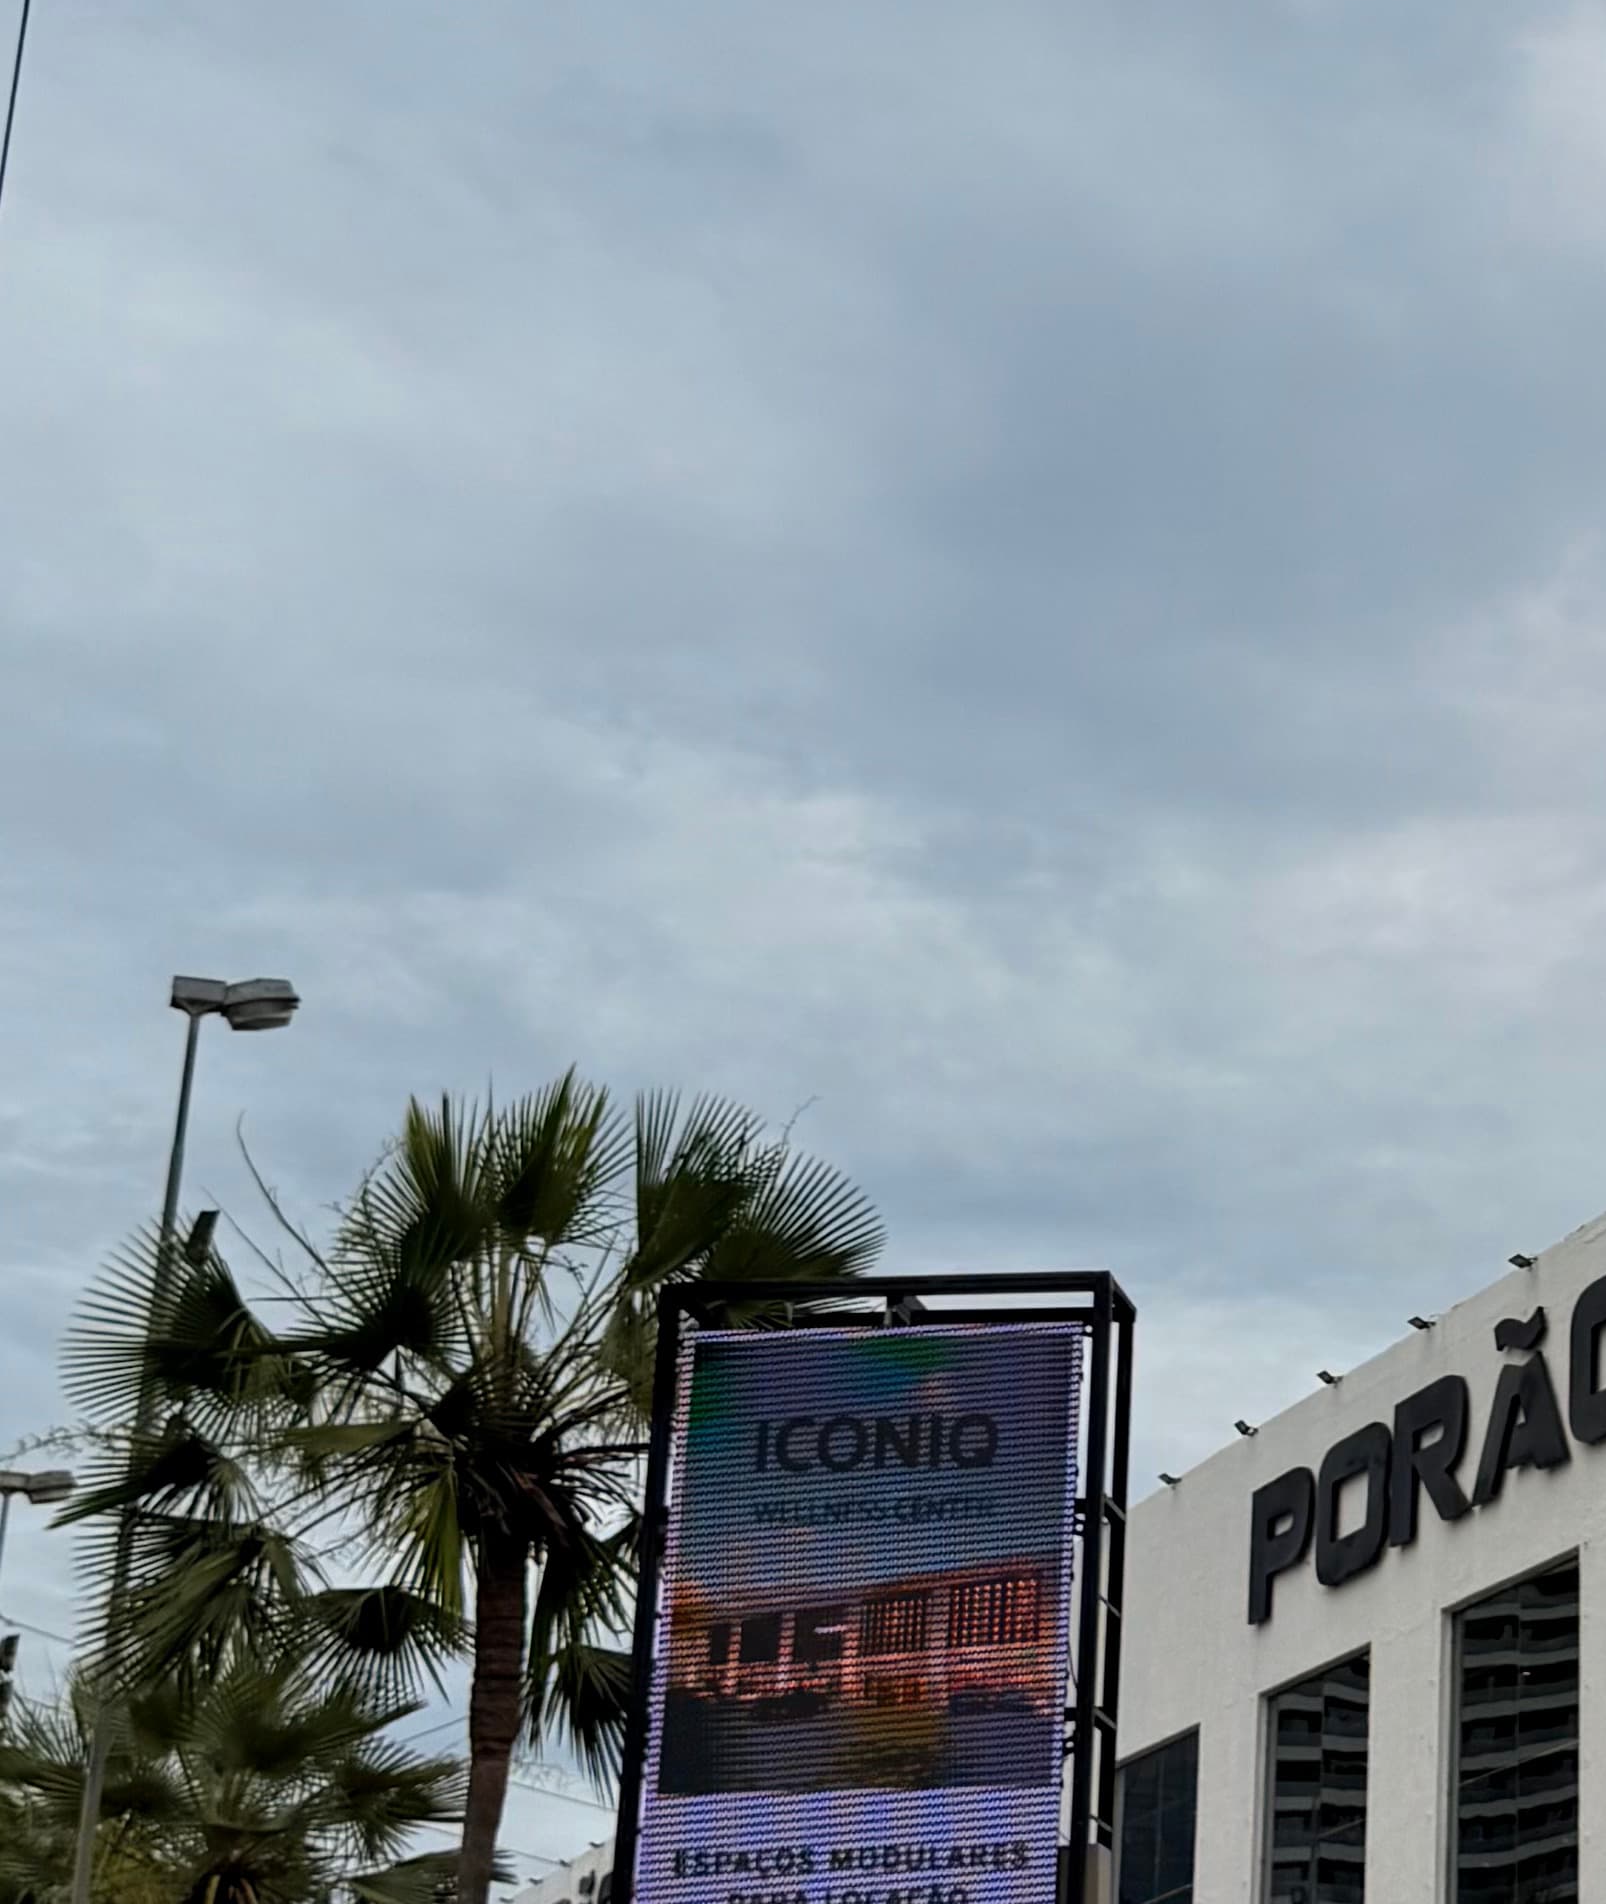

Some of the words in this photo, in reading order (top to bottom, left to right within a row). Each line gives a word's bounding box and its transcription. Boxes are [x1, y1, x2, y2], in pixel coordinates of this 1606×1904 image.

[755, 1413, 998, 1473] ICONIQ
[673, 1846, 815, 1879] ESPAÇOS
[829, 1841, 1030, 1873] MODULARES
